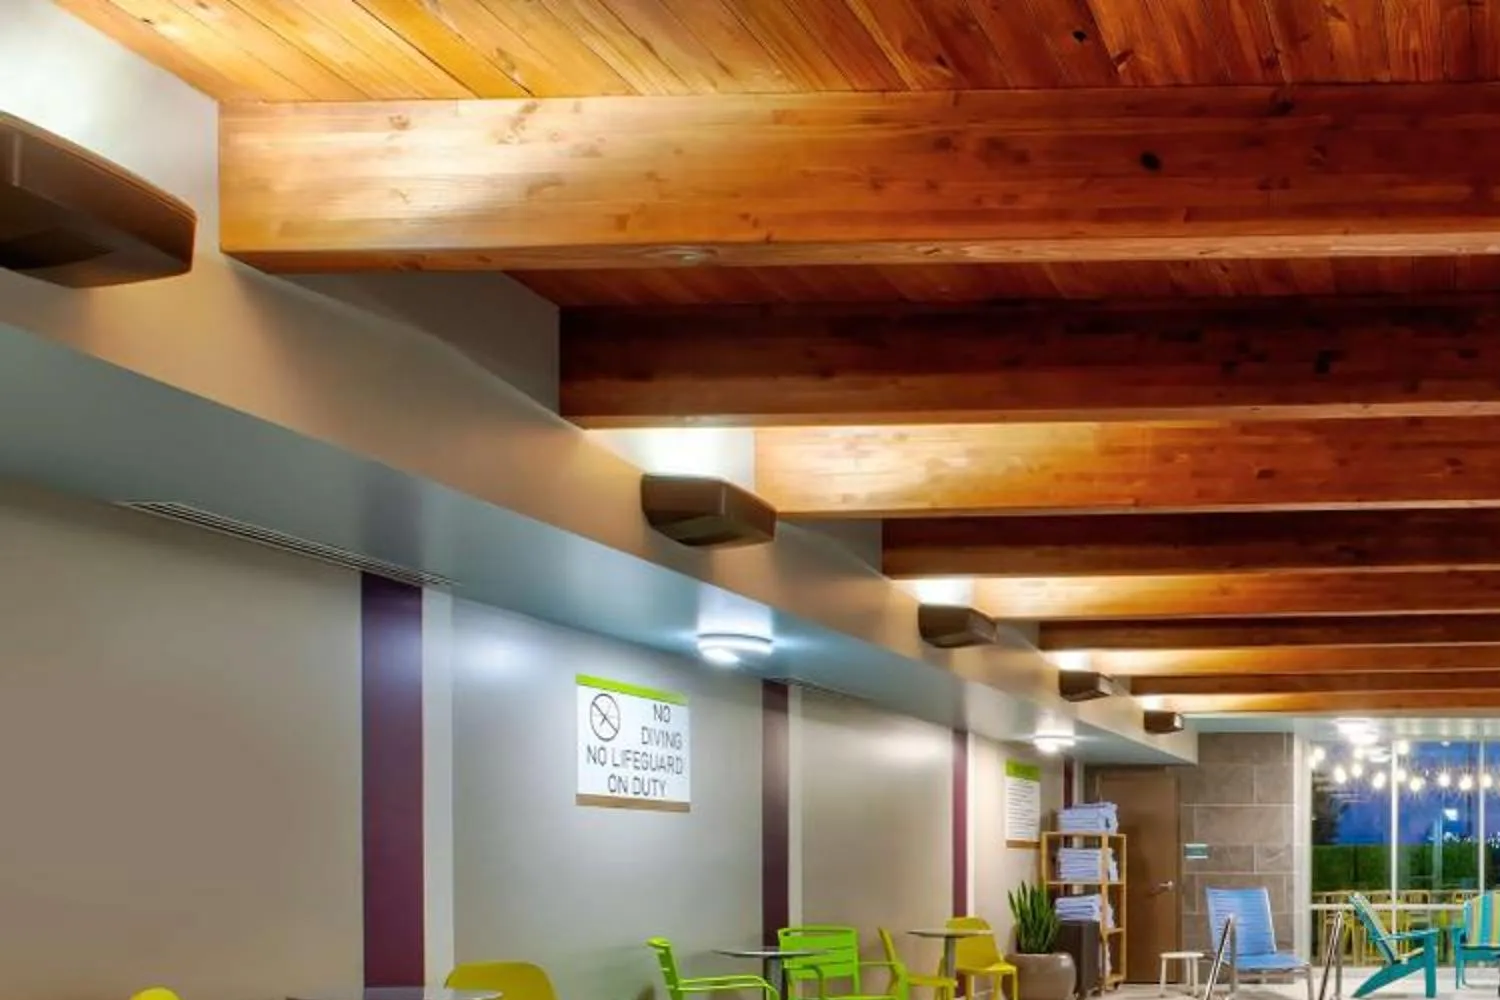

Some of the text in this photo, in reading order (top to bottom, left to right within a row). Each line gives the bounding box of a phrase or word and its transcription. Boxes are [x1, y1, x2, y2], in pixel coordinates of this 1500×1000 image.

[653, 703, 671, 723] NO
[641, 726, 683, 751] DIVING
[587, 744, 684, 775] NO LIFEGUARD
[608, 774, 667, 797] ON DUTY
